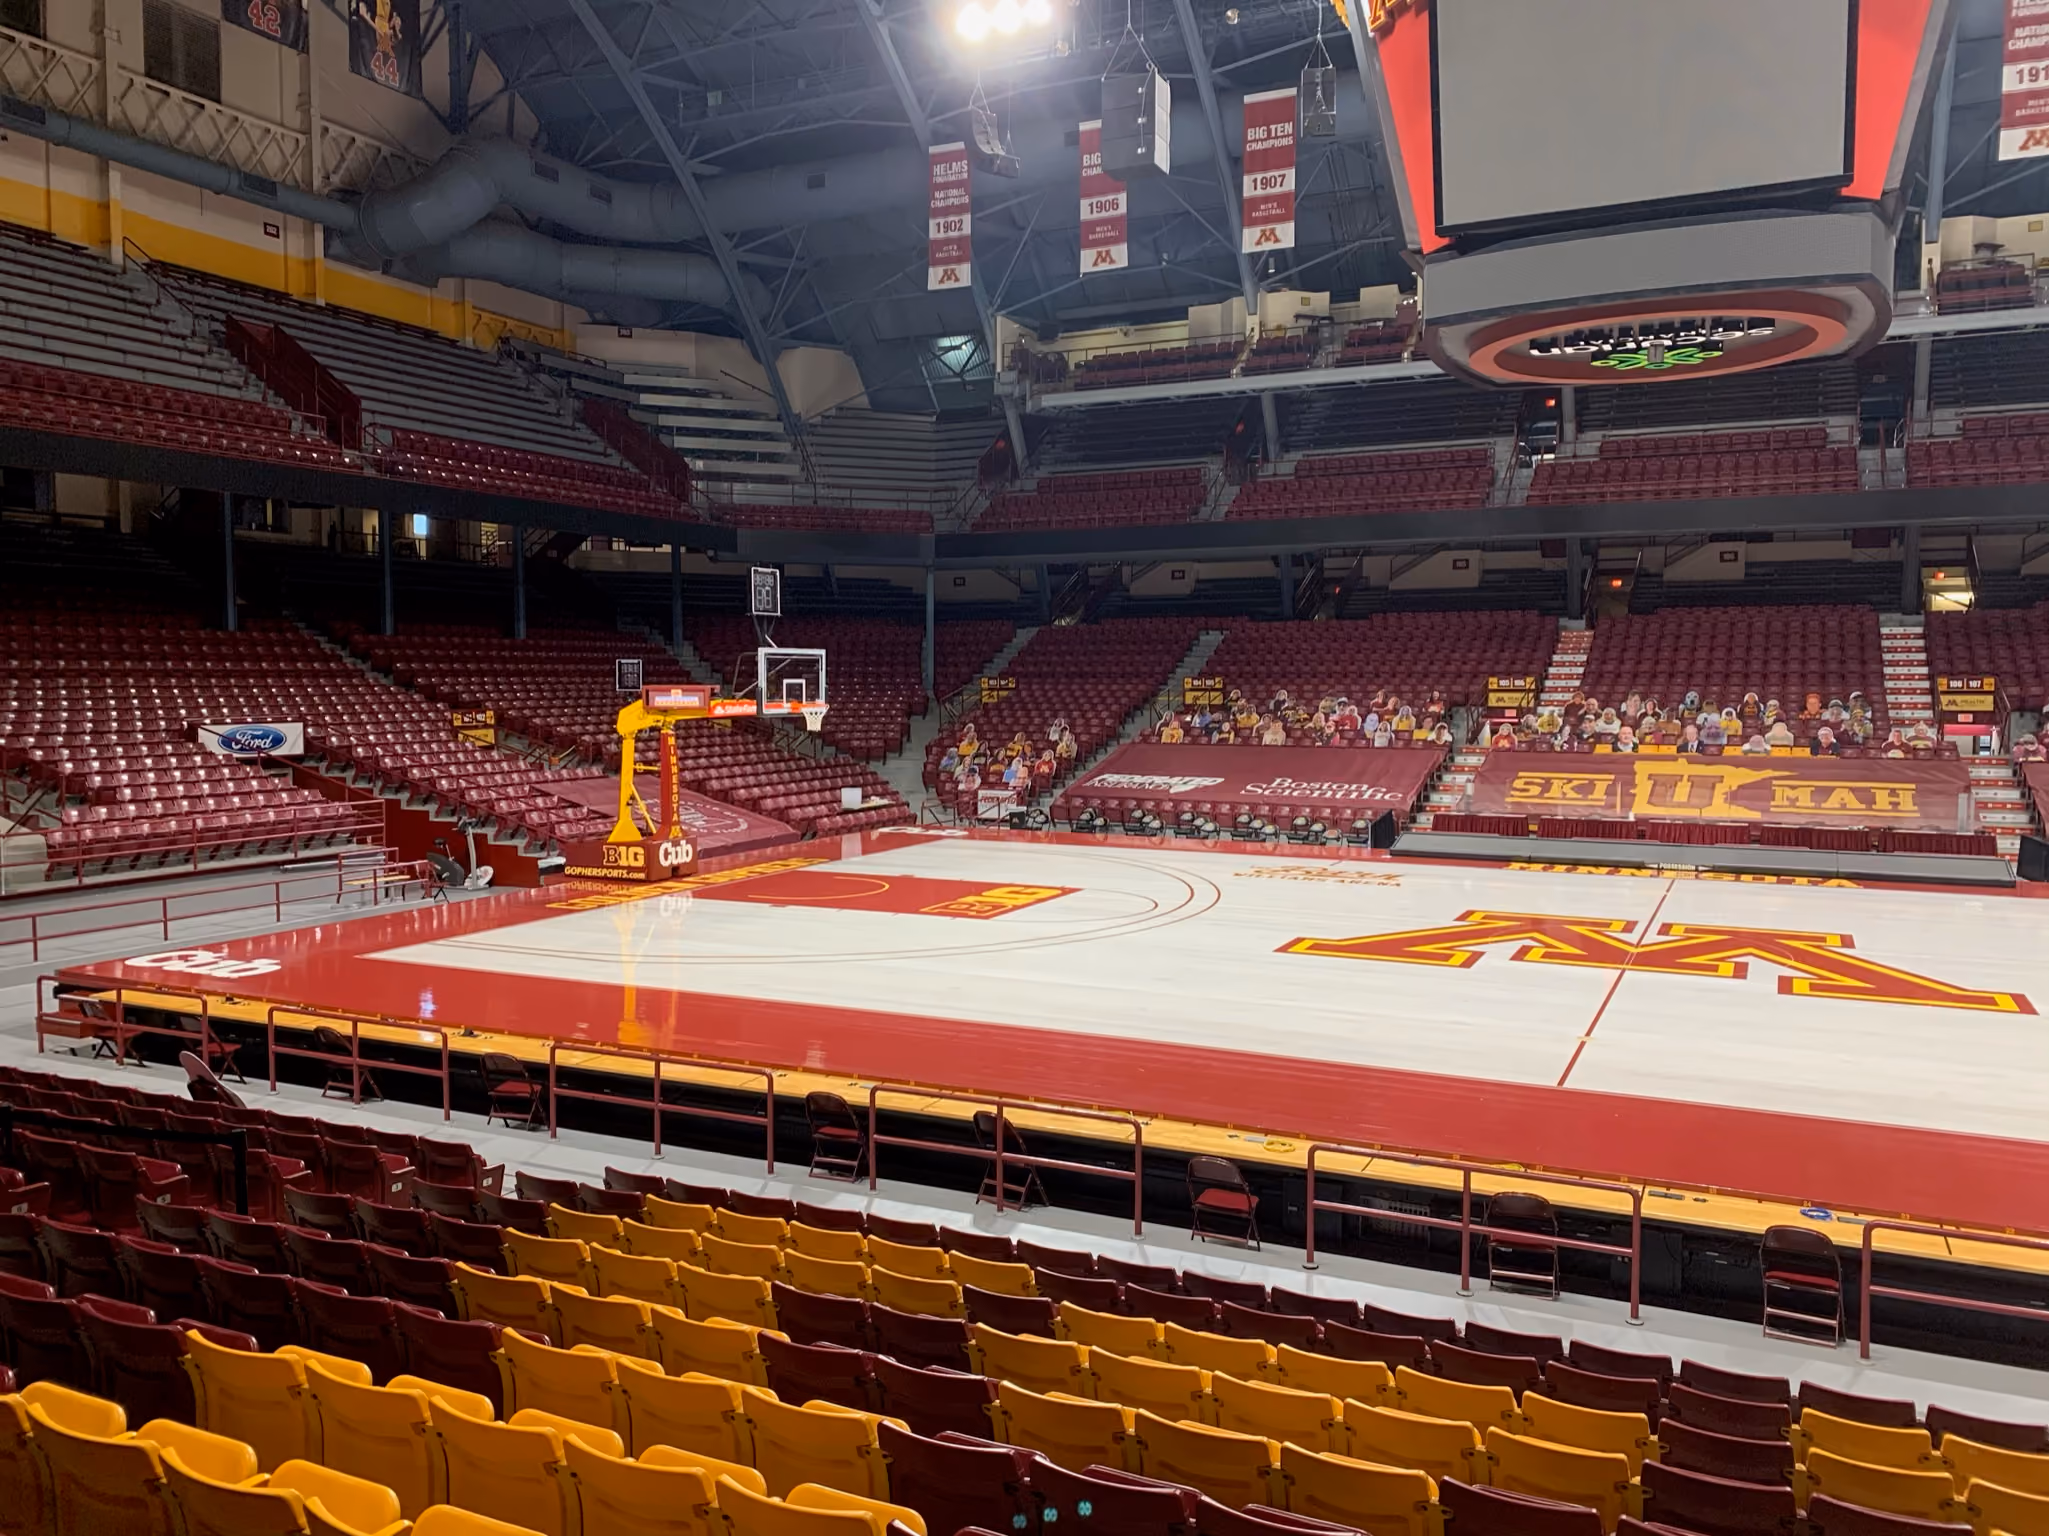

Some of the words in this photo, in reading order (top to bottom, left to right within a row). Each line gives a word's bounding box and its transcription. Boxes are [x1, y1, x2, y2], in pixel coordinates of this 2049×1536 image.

[248, 0, 281, 37] 42
[371, 52, 399, 87] 44
[1247, 125, 1268, 141] BIG
[1270, 121, 1293, 137] TEN
[1246, 135, 1294, 152] CHAMPIONS
[933, 159, 968, 177] HELMS
[1083, 152, 1102, 167] BIG
[1251, 173, 1287, 192] 1907
[1088, 197, 1120, 216] 1906
[936, 218, 964, 235] 1902
[1529, 326, 1776, 357] securian
[1970, 680, 1981, 688] 107
[231, 729, 273, 750] Ford
[668, 735, 679, 822] MINNESOTA
[1269, 777, 1370, 791] Boston
[1239, 783, 1403, 801] Scientific
[1510, 777, 1613, 799] SKI
[1647, 773, 1725, 809] U
[1770, 786, 1919, 811] MAH
[659, 840, 693, 867] Cub
[564, 866, 646, 879] GOPHERSPORTS.com
[1659, 862, 1697, 871] POSSESSION
